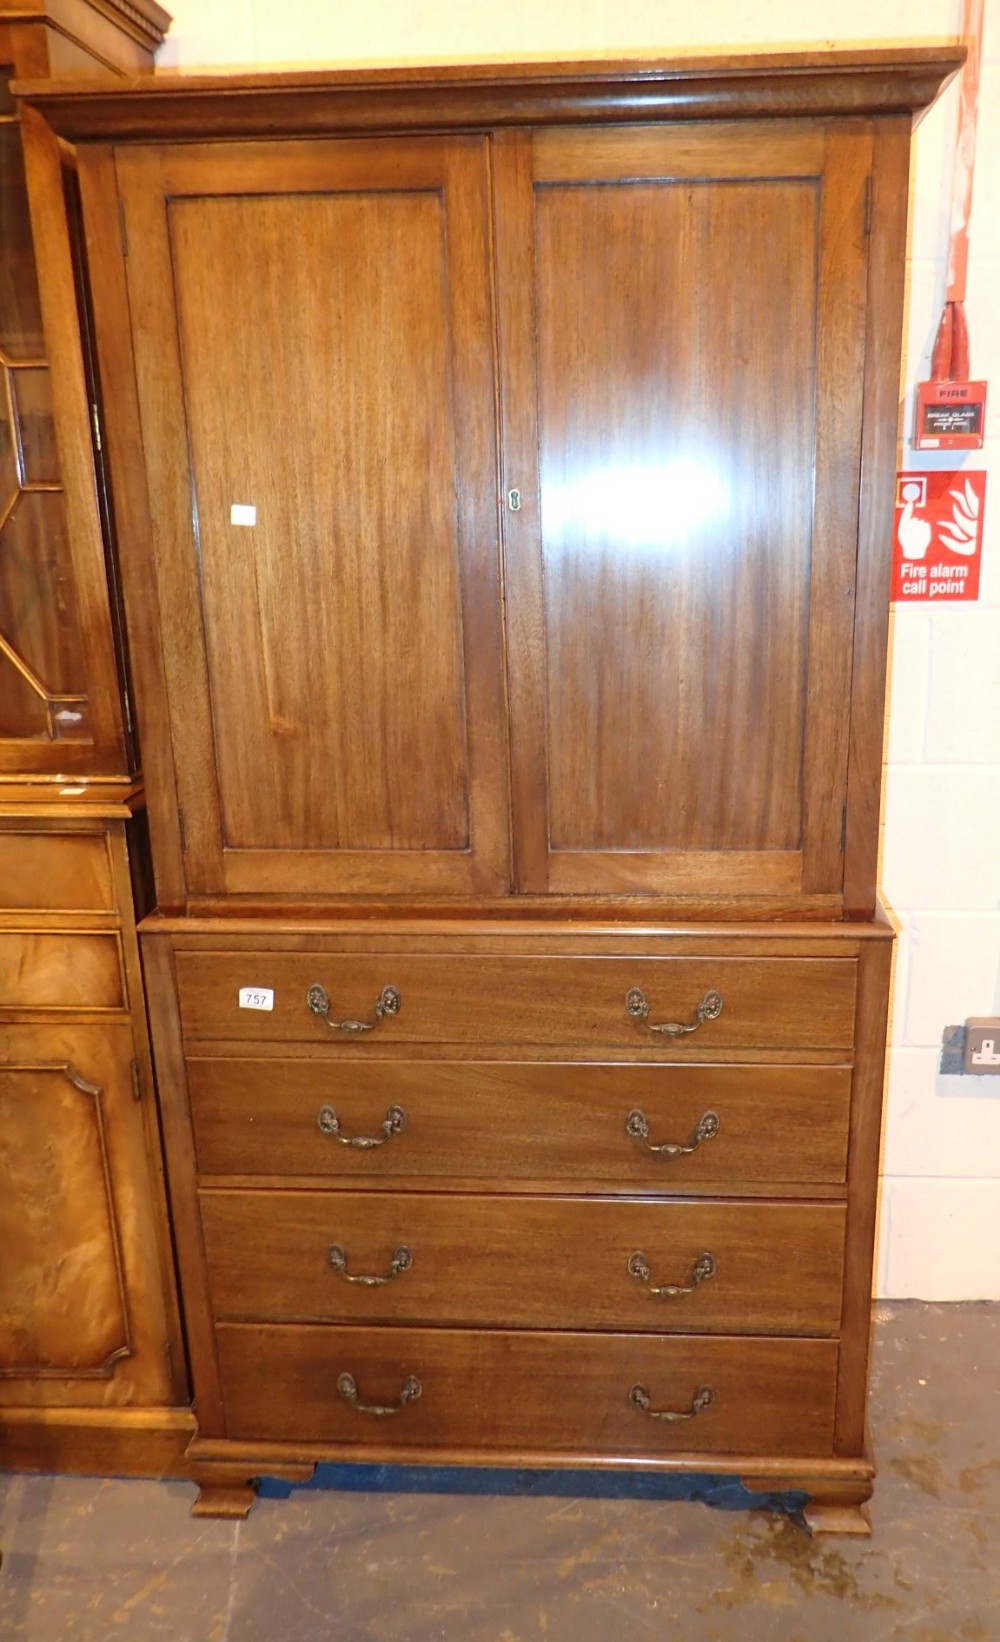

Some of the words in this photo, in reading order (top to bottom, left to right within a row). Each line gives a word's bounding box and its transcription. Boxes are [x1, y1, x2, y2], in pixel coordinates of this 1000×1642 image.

[939, 389, 968, 398] FIRE
[900, 563, 927, 579] Fire
[929, 563, 968, 579] alarm
[902, 579, 926, 594] call
[929, 579, 965, 597] point
[245, 994, 267, 1005] 757
